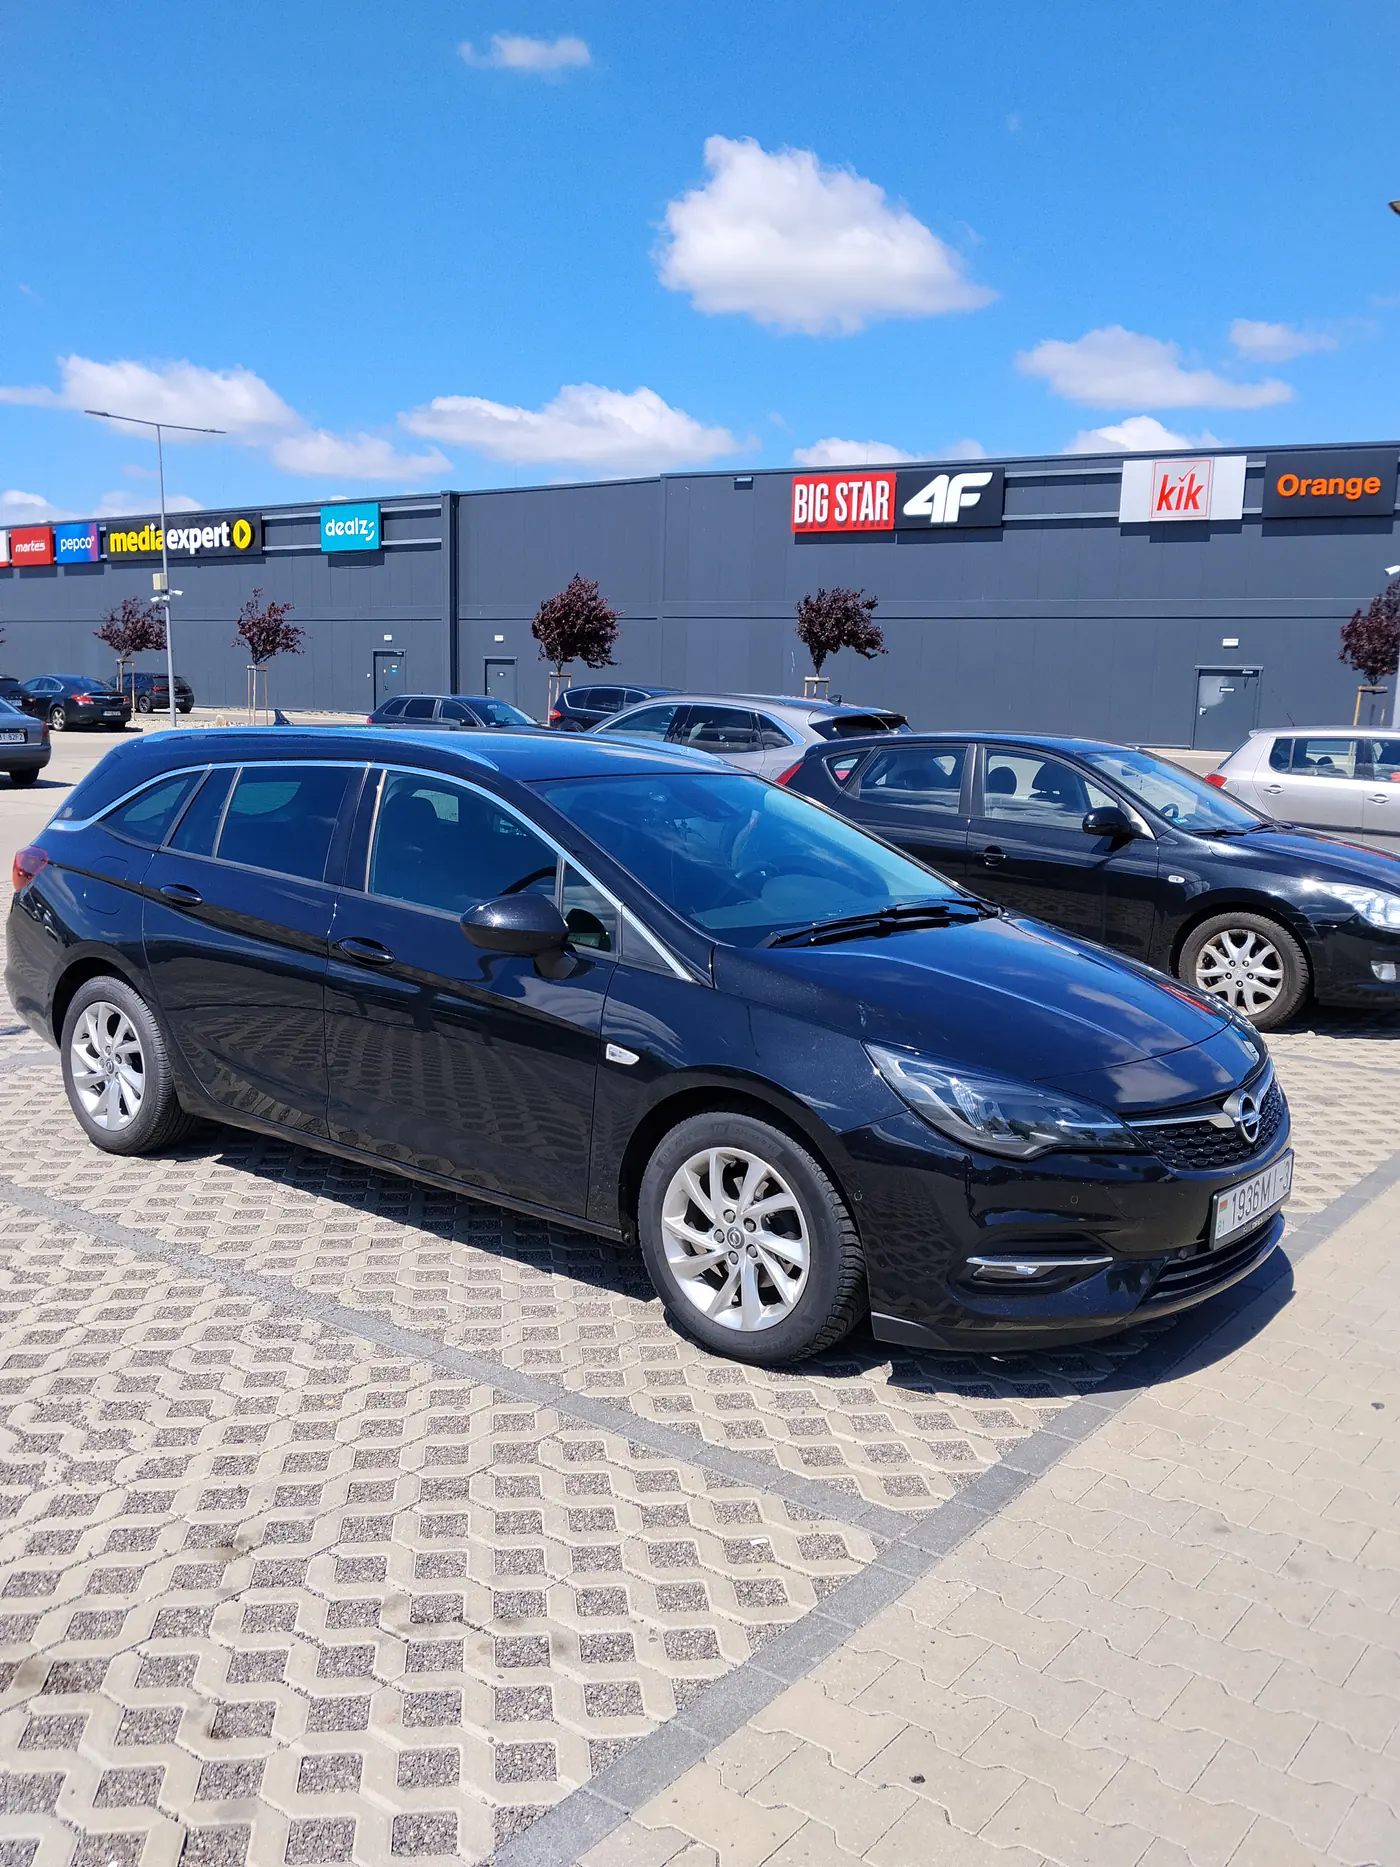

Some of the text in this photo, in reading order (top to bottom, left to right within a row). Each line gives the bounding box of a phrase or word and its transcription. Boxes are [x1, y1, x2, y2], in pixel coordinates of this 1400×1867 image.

[903, 472, 993, 523] 4F
[1156, 467, 1204, 511] kik
[1277, 474, 1381, 500] Orange
[794, 481, 890, 523] BIG STAR
[325, 517, 370, 537] dealz
[15, 540, 46, 552] martes
[60, 537, 92, 552] pepco
